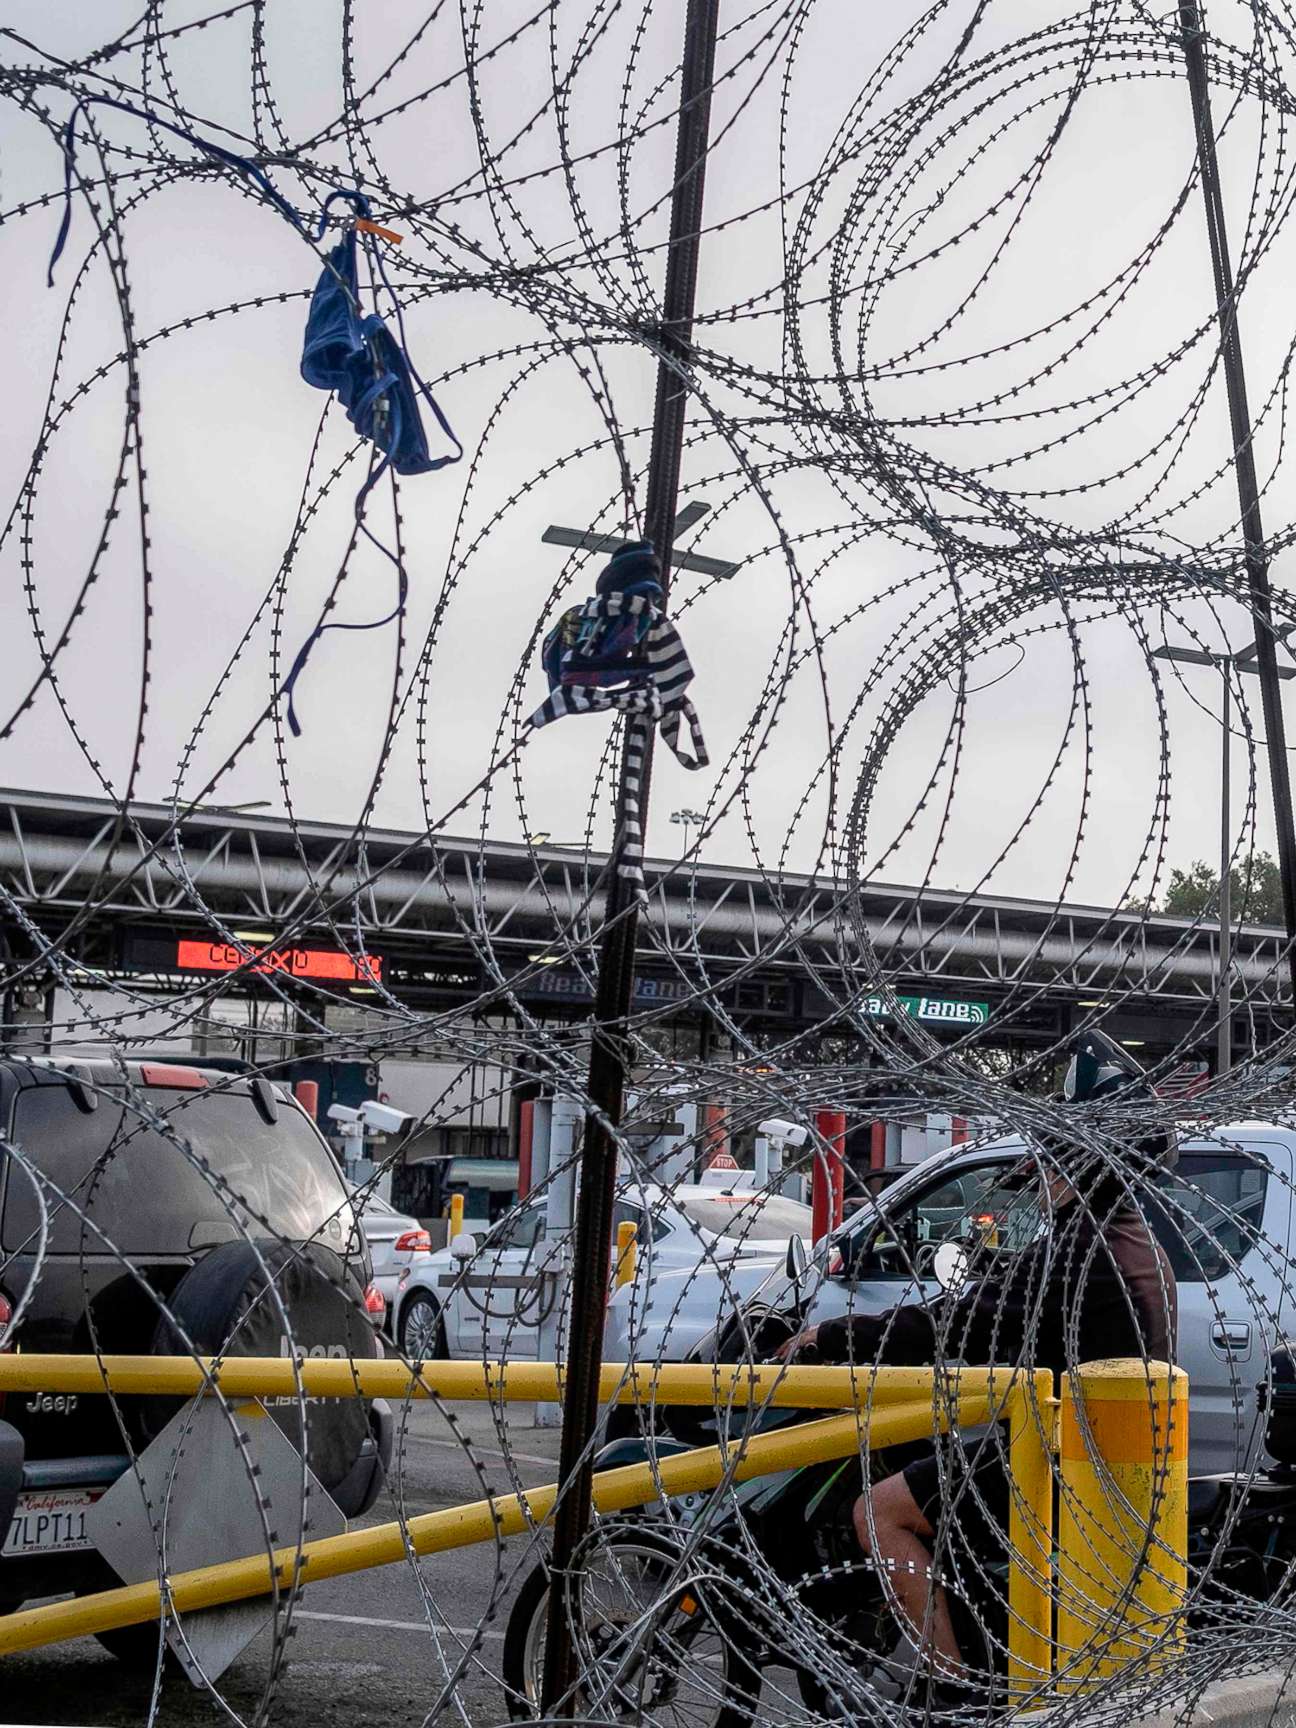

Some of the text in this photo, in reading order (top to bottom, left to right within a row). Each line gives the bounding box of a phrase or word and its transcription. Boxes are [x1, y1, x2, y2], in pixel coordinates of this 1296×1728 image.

[716, 1158, 733, 1168] STOP
[26, 1391, 78, 1416] Jeep
[12, 1512, 88, 1547] 7LPT11
